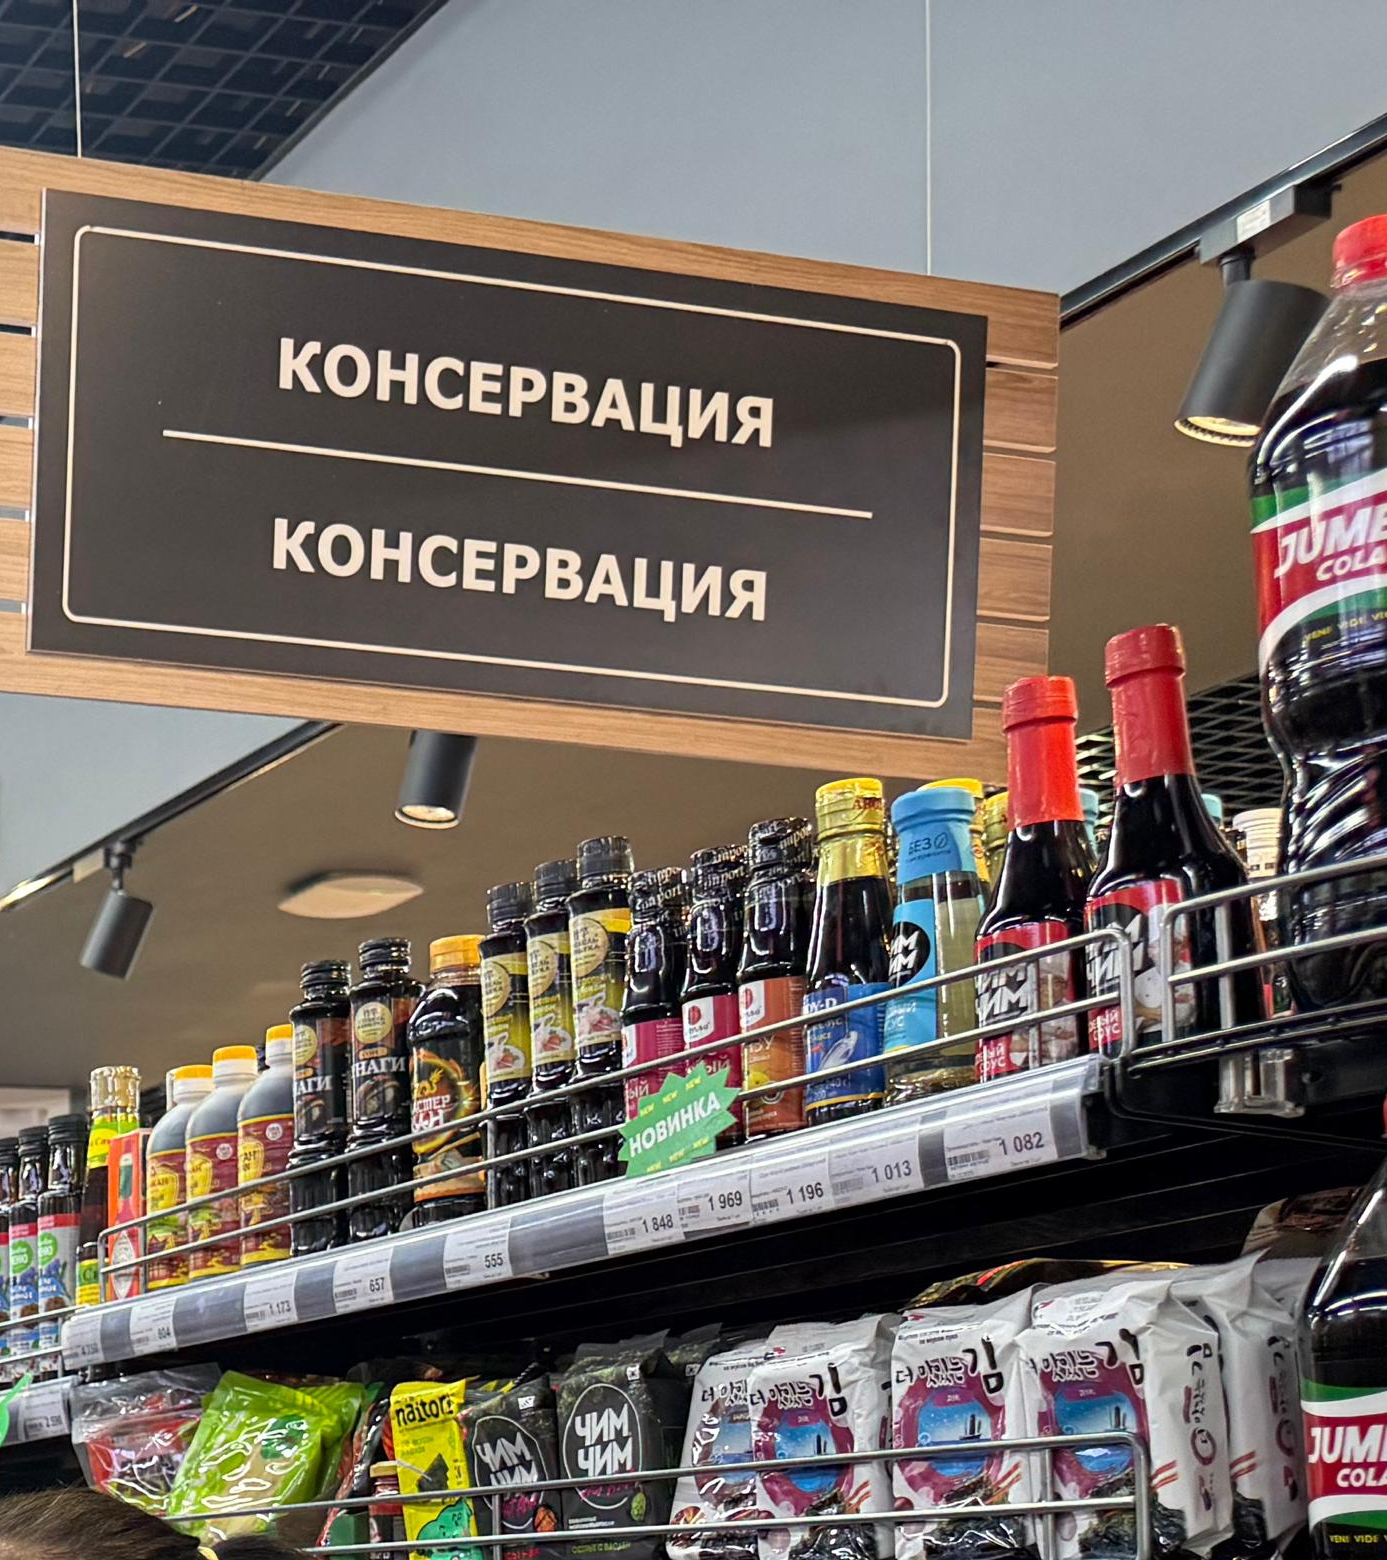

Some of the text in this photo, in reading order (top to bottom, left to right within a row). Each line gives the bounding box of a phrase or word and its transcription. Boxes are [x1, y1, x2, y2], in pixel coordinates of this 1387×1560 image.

[278, 336, 774, 449] КОНСЕРВАЦИЯ
[271, 517, 768, 622] КОНСЕРВАЦИЯ
[629, 1091, 721, 1158] НОВИНКА
[998, 1132, 1045, 1156] 1 082
[872, 1160, 913, 1183] 1 013
[708, 1190, 743, 1211] 1 969
[787, 1181, 825, 1205] 1 196
[641, 1213, 674, 1233] 1 848
[483, 1251, 504, 1269] 555
[367, 1276, 386, 1293] 657
[574, 1403, 629, 1446] ЧИМ
[476, 1431, 532, 1471] ЧИМ
[577, 1437, 634, 1477] ЧИМ
